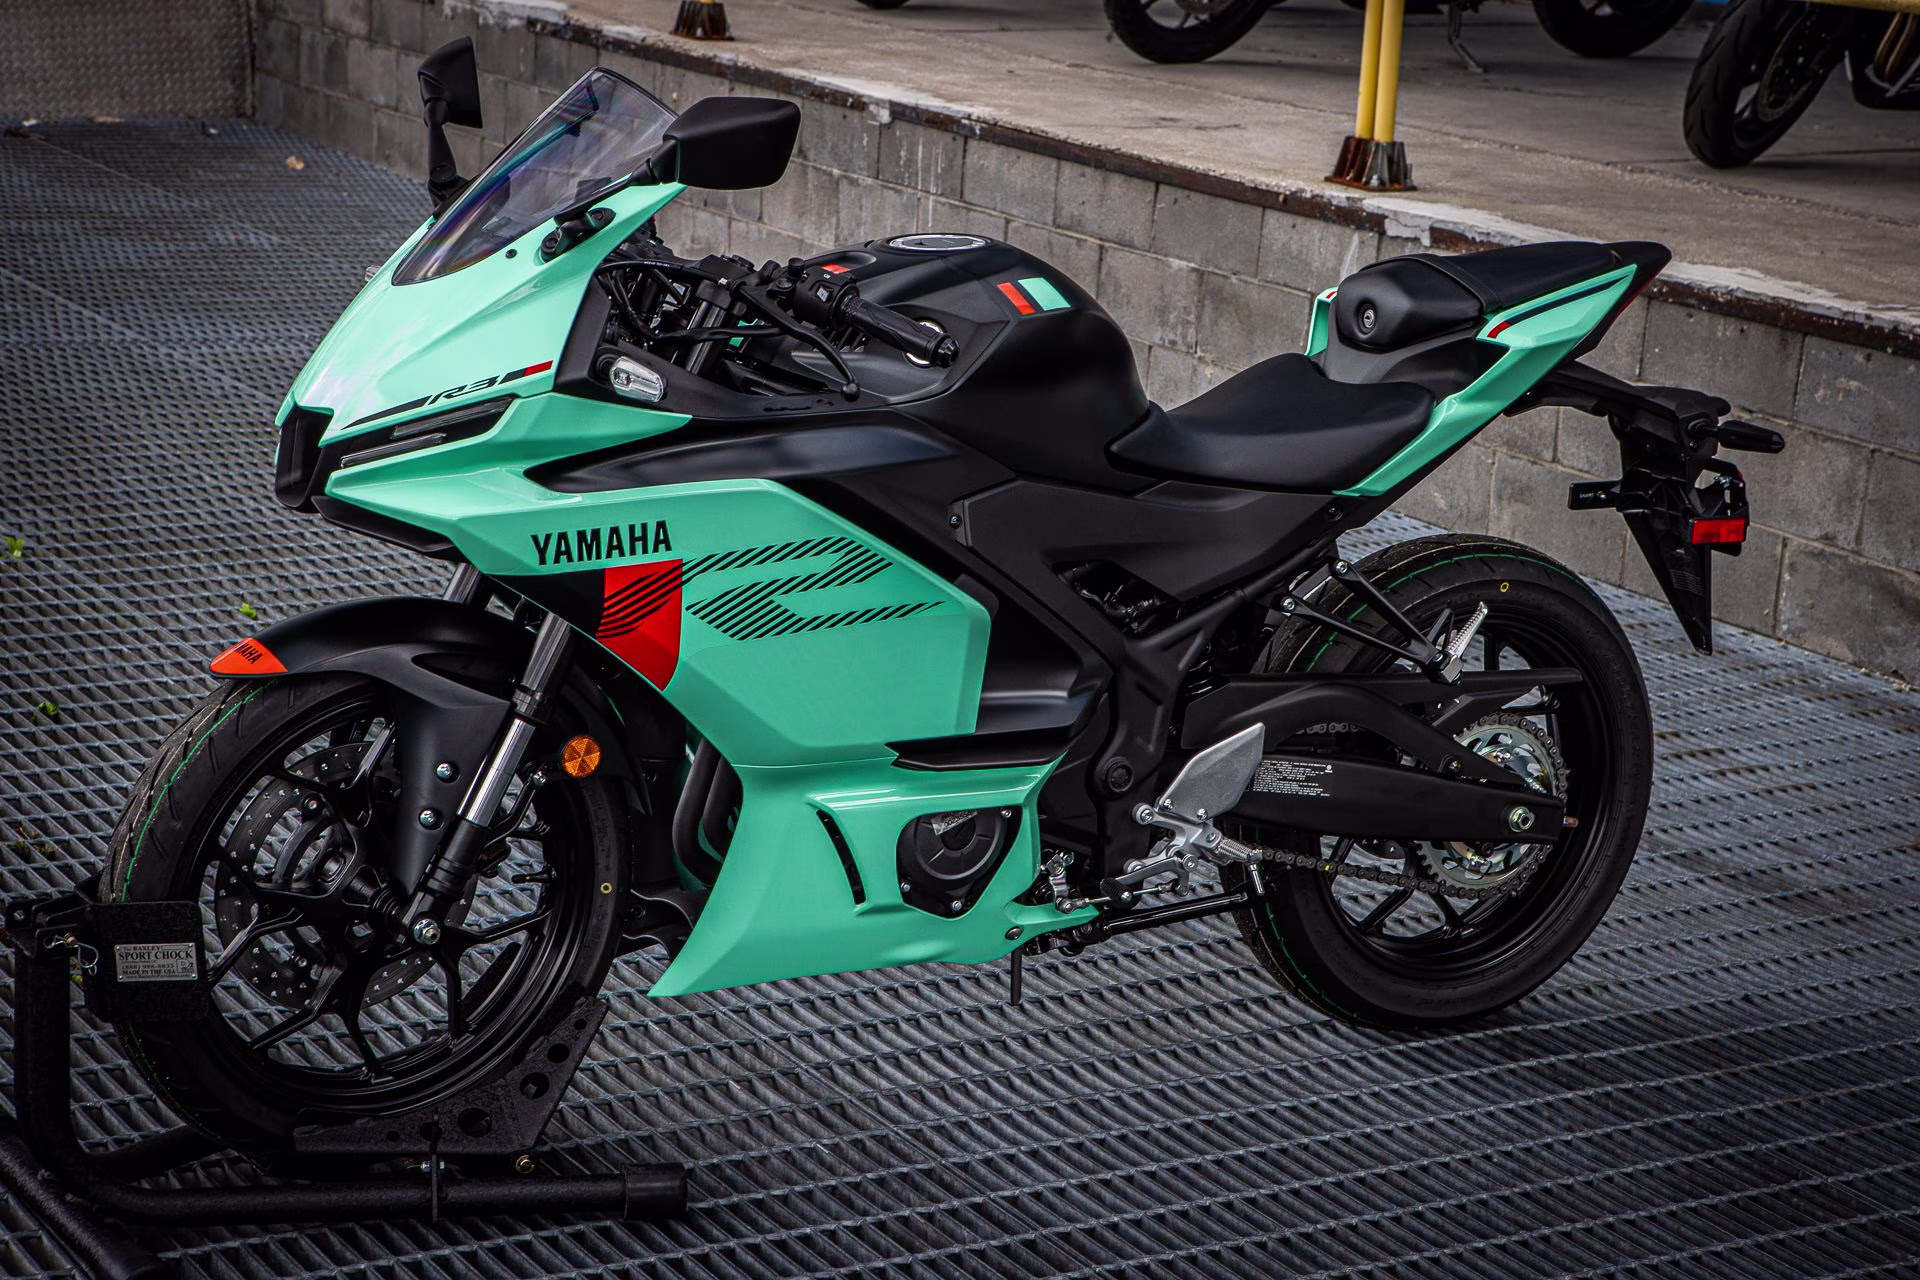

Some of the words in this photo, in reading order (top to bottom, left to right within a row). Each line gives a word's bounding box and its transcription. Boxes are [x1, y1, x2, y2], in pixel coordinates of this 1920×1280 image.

[428, 375, 500, 405] R3
[530, 520, 673, 566] YAMAHA
[118, 951, 153, 961] SPORT
[154, 950, 193, 960] CHOCK
